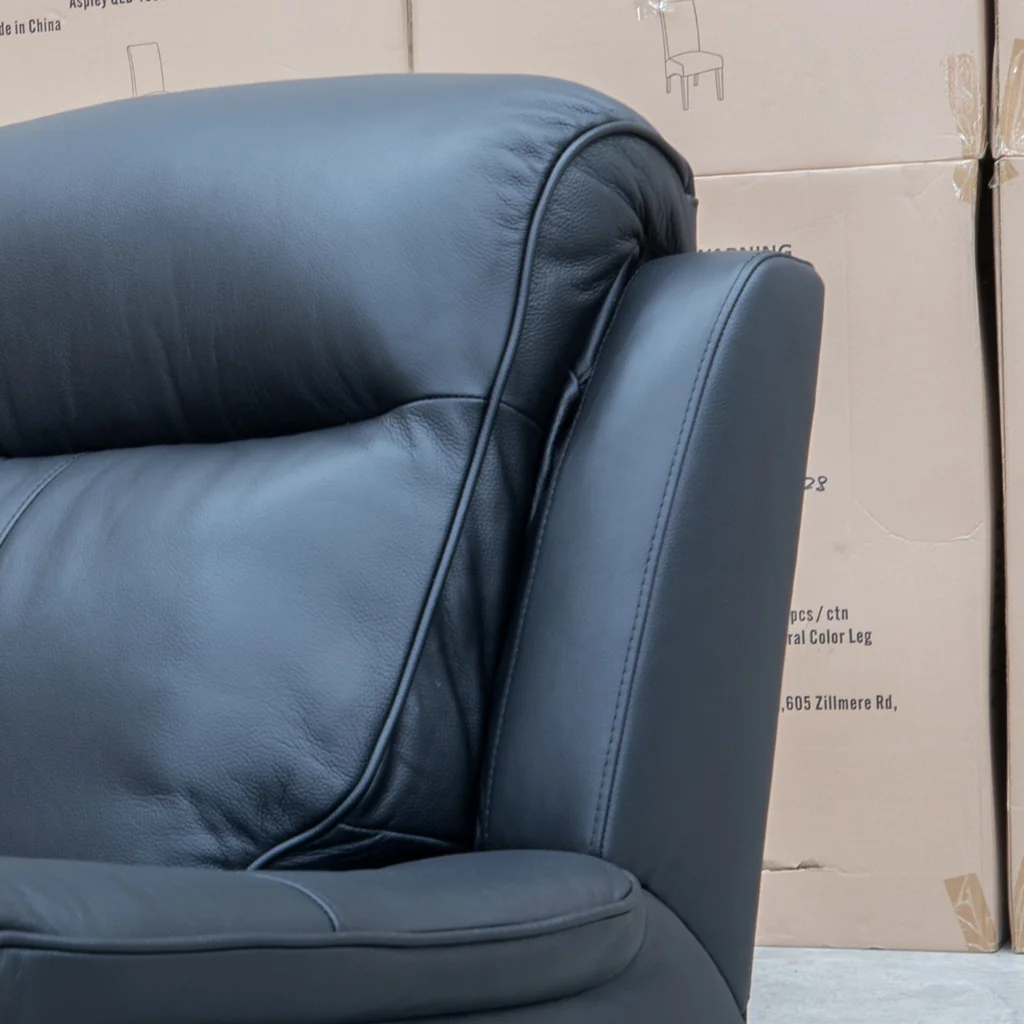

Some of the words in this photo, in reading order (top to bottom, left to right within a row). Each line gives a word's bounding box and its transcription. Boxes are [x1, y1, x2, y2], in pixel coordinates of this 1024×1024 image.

[14, 20, 26, 36] in
[28, 17, 62, 34] China
[809, 628, 845, 645] Color
[848, 627, 873, 647] Leg
[814, 694, 872, 711] Zillmere
[875, 693, 898, 712] Rd,
